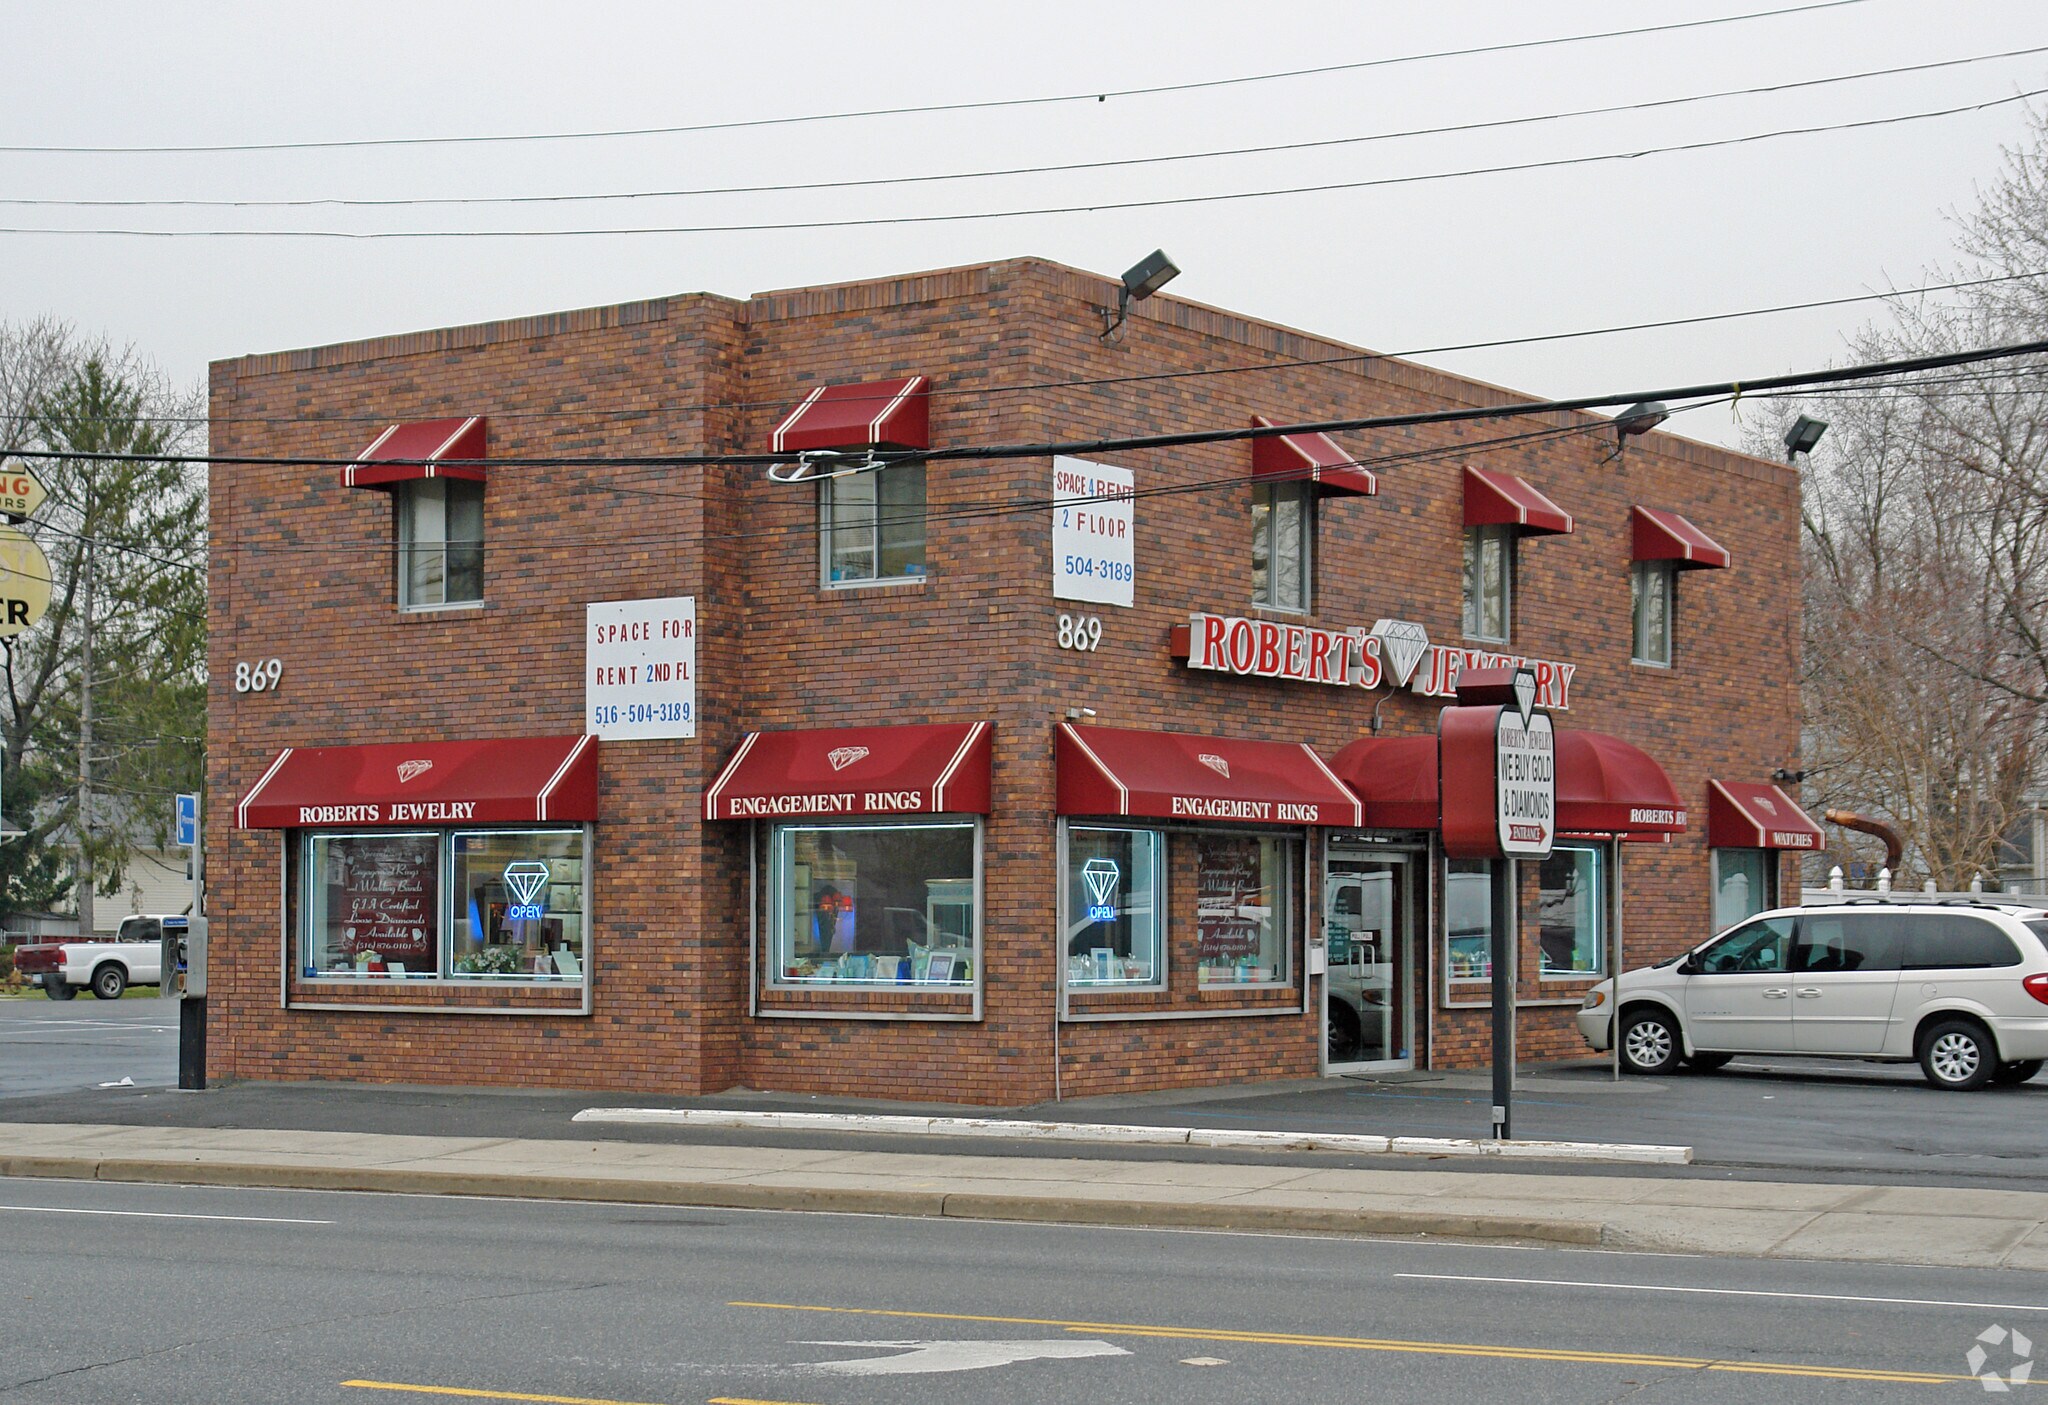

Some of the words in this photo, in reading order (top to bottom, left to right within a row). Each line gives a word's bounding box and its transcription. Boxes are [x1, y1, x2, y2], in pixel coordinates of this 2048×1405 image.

[1056, 470, 1086, 496] SPACE
[1088, 478, 1094, 498] 4
[1096, 479, 1133, 504] RENT
[0, 497, 26, 509] RS
[1062, 508, 1069, 528] 2
[1077, 512, 1126, 539] FLOOR
[1065, 555, 1132, 582] 504-3189
[597, 621, 650, 644] SPACE
[662, 619, 692, 639] FOR
[1058, 614, 1102, 651] 869
[596, 666, 638, 686] RENT
[646, 663, 671, 683] 2ND
[676, 661, 690, 681] FL
[1200, 613, 1382, 690] ROBERT'S
[1425, 645, 1576, 710] JERY
[235, 658, 283, 693] 869
[1501, 753, 1513, 781] WE
[1515, 753, 1530, 782] BUY
[1532, 754, 1552, 782] GOLD
[299, 804, 380, 824] ROBERTS
[388, 801, 476, 821] JEWELRY
[730, 792, 856, 816] ENGAGEMENT
[864, 791, 922, 811] RINGS
[1171, 796, 1272, 819] ENGAGEMENT
[1277, 803, 1319, 822] RINGS
[1504, 788, 1509, 817] &
[1511, 789, 1550, 819] DIAMONDS
[1630, 808, 1674, 825] ROBERTS
[1512, 826, 1540, 839] ENTRANCE
[1772, 831, 1813, 847] WATCHES
[510, 905, 541, 918] OPEN
[1090, 905, 1114, 919] OPEN
